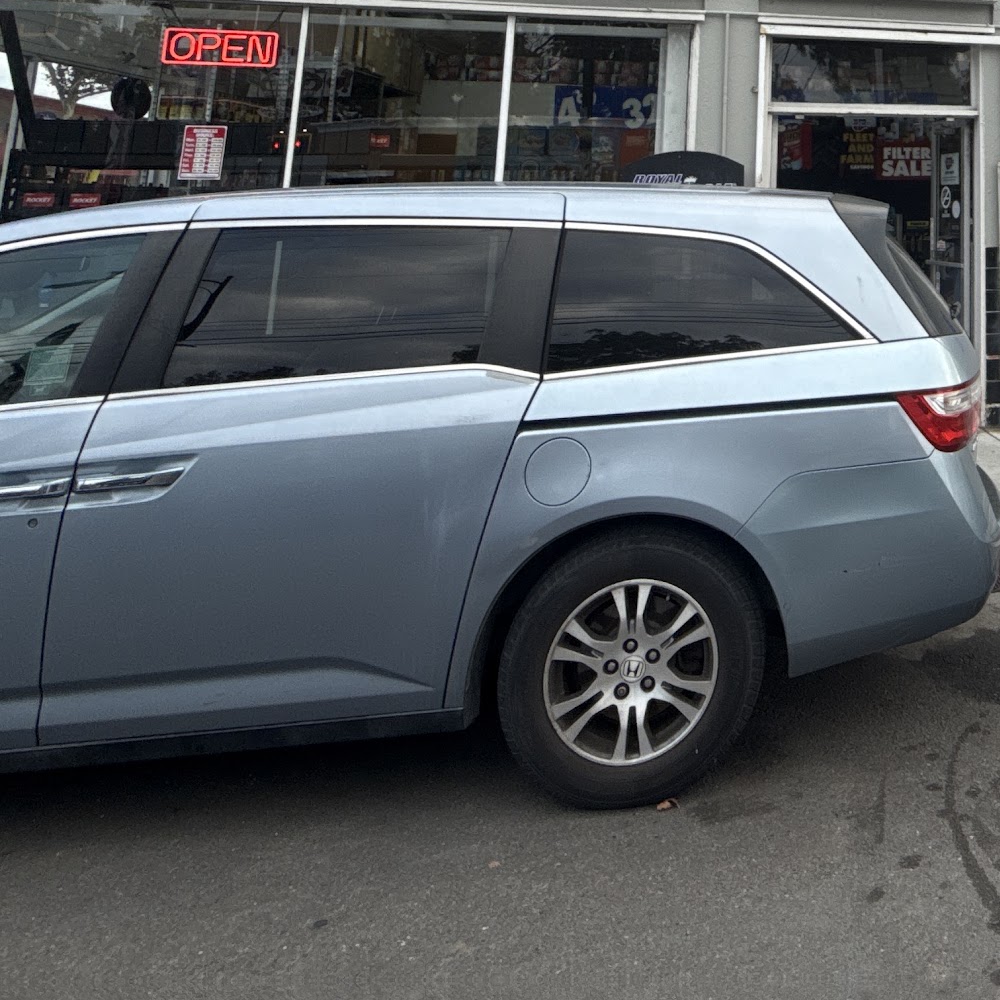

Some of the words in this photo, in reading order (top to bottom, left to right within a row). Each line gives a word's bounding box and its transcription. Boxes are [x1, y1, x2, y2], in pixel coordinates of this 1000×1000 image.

[168, 31, 273, 65] OPEN
[842, 131, 875, 143] FLEET
[839, 154, 875, 165] FARM
[883, 146, 931, 160] FILTER
[881, 159, 932, 177] SALE
[633, 173, 683, 184] ROYAL
